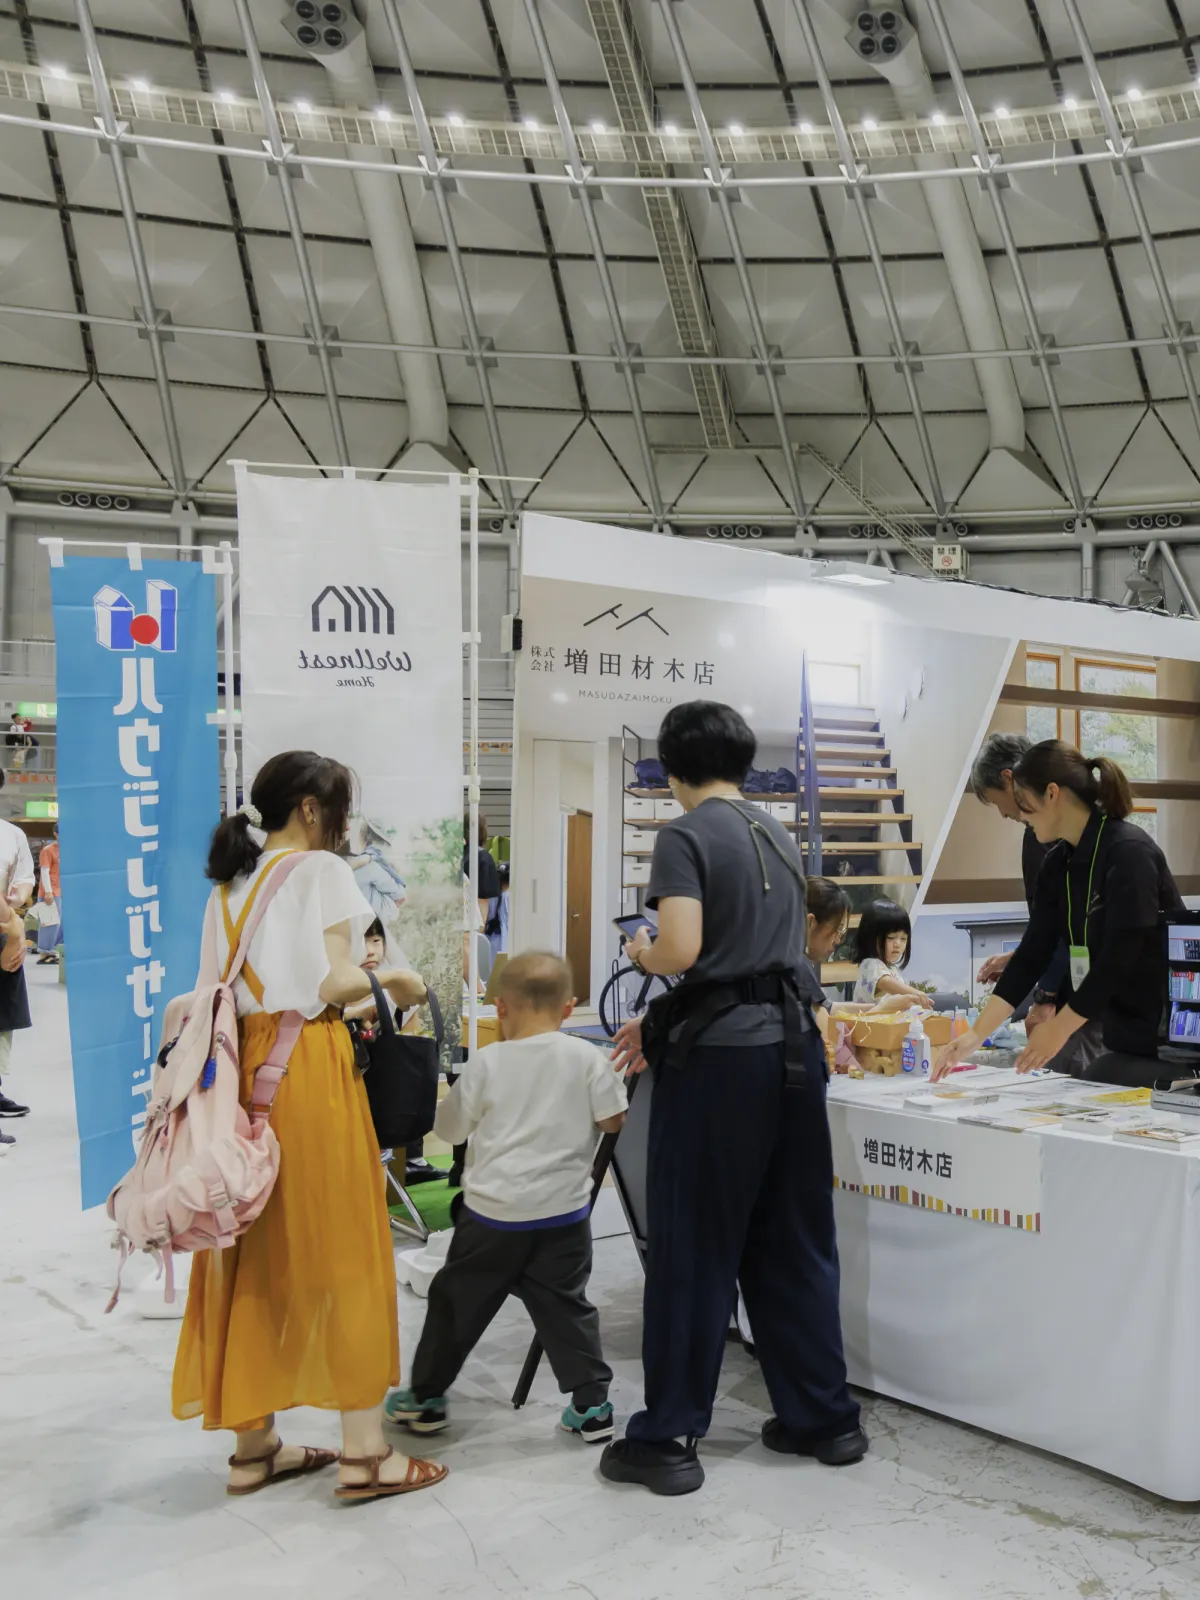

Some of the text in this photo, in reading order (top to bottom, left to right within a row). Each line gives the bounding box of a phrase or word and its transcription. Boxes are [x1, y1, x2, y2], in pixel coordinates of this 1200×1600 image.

[530, 646, 555, 659] 株式
[530, 659, 555, 672] 会社
[564, 648, 715, 685] 増田材木店
[578, 690, 672, 704] MASUDAZAIMOKU
[864, 1138, 953, 1179] 増田材木店
